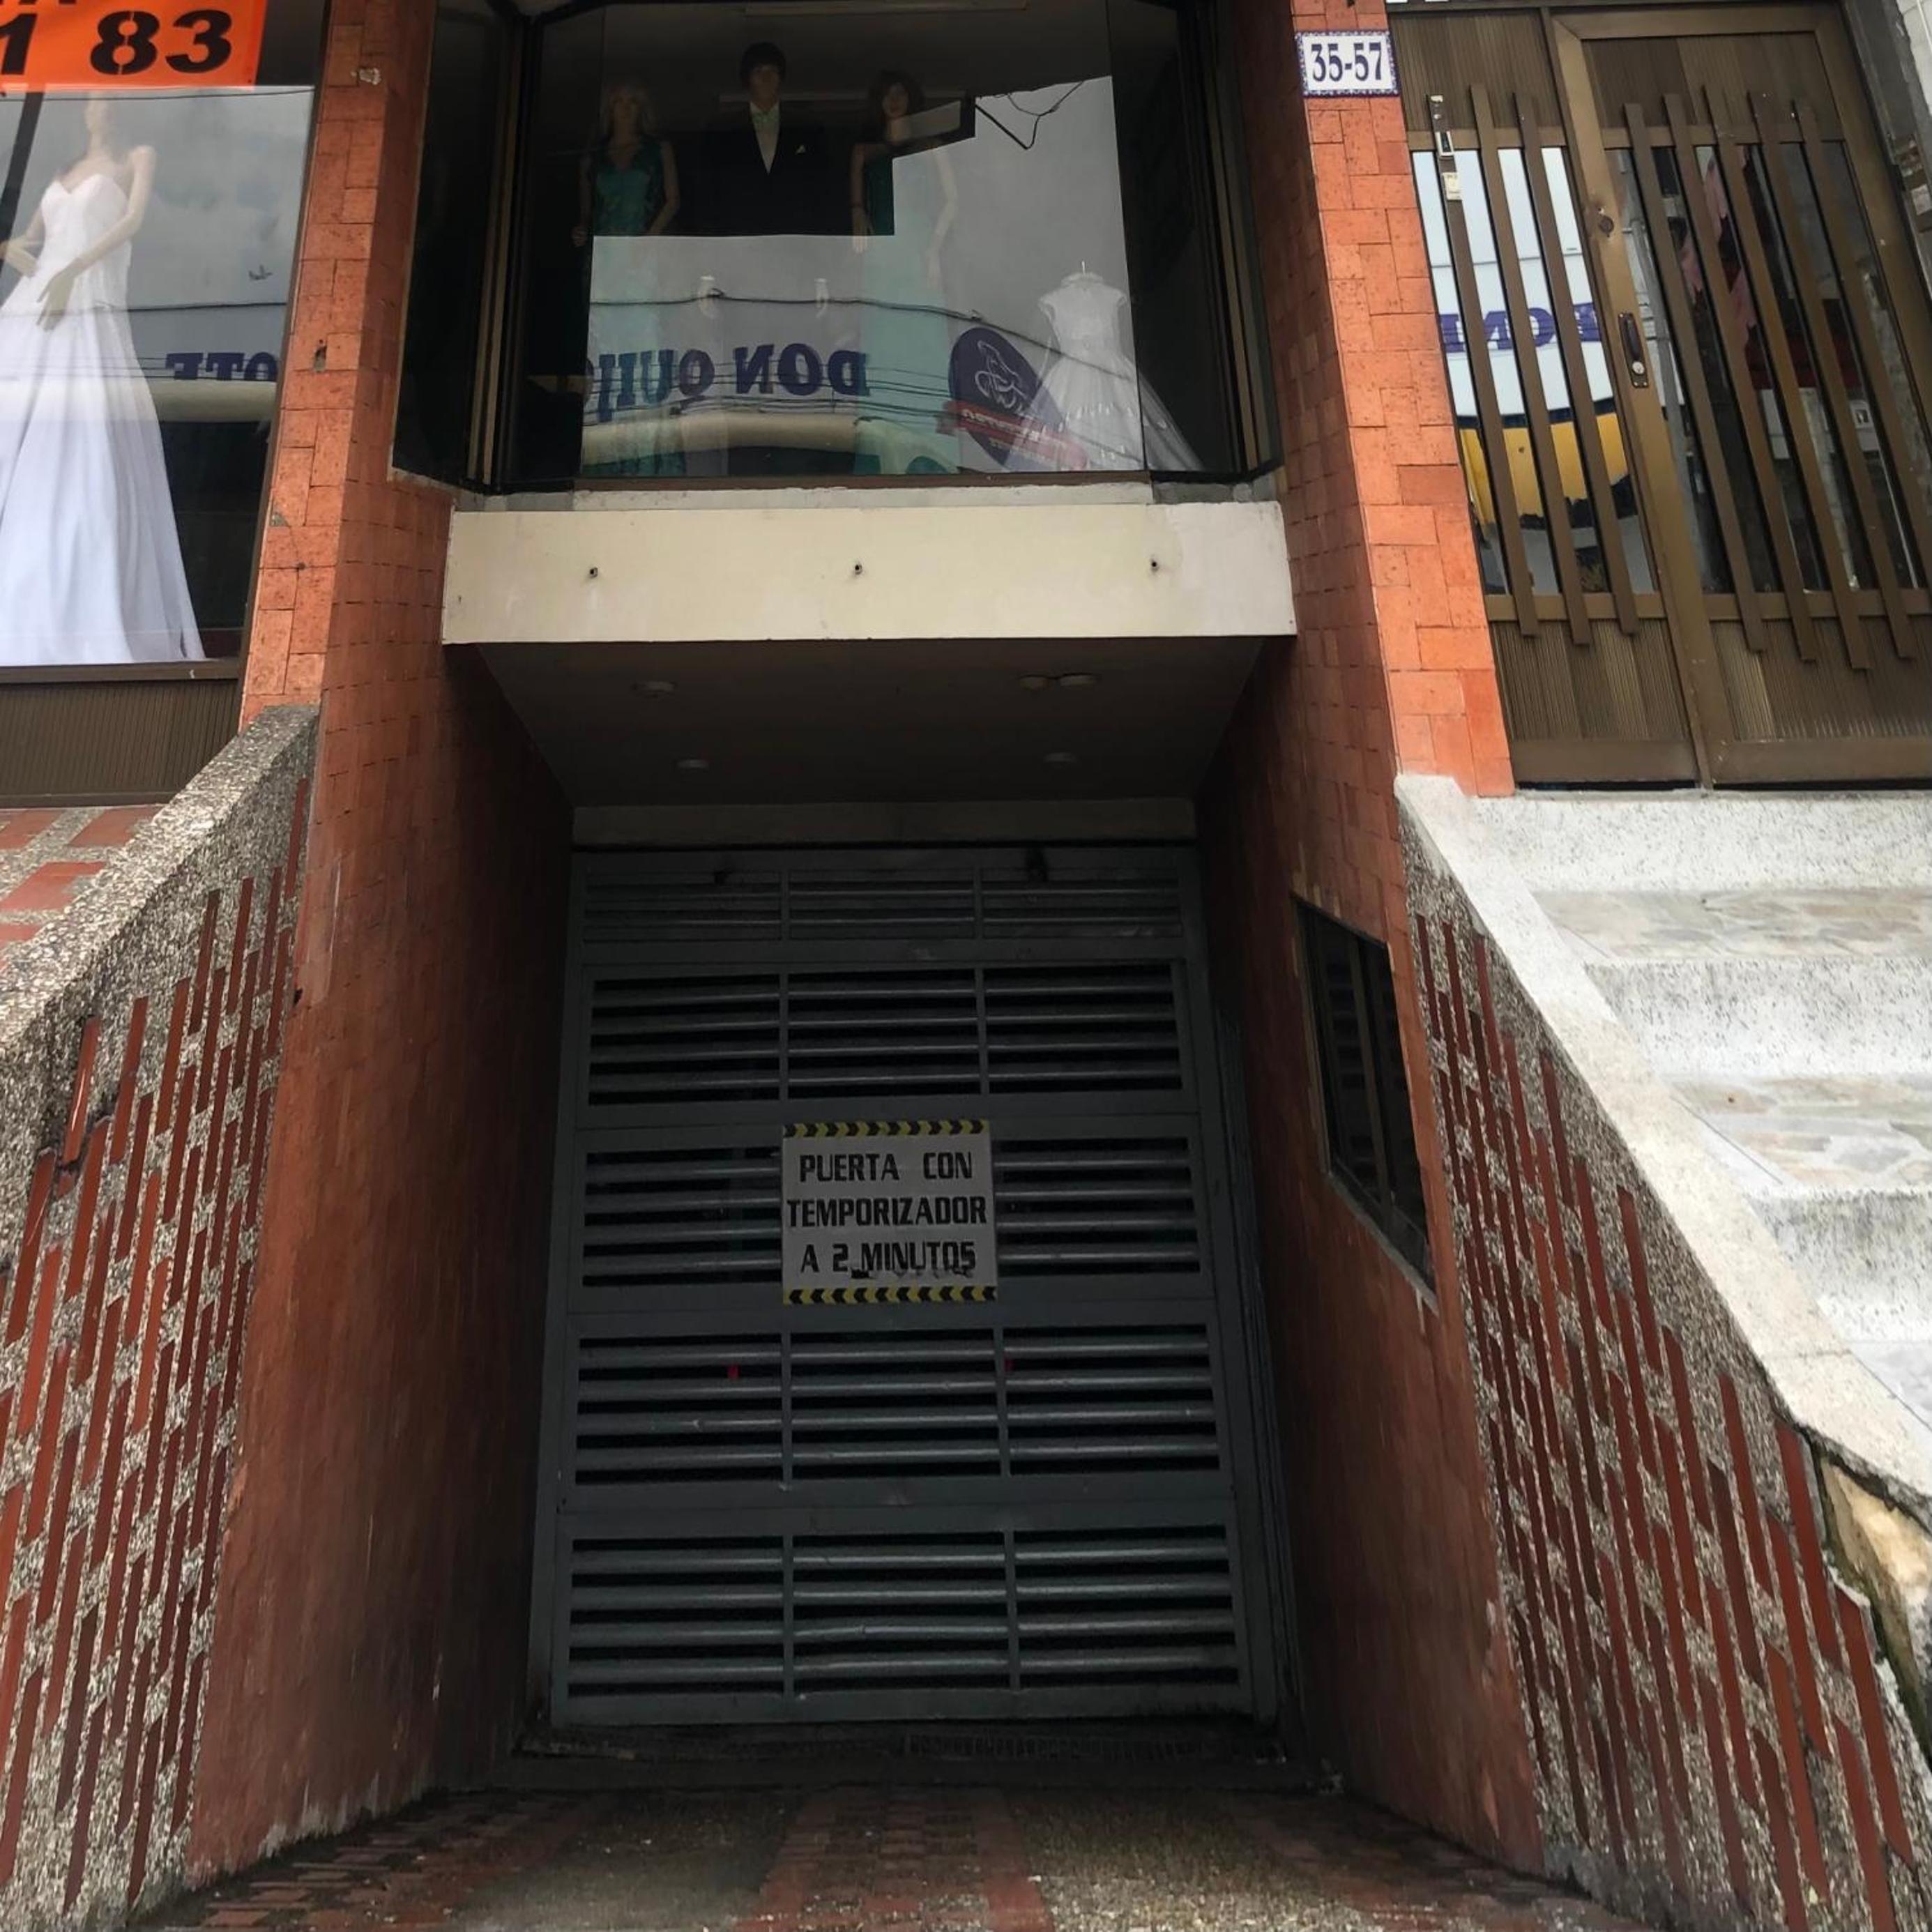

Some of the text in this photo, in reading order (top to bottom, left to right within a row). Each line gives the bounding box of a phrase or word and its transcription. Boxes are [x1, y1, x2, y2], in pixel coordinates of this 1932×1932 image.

[90, 9, 233, 75] 83
[1311, 42, 1382, 82] 35-57
[800, 1152, 973, 1183] PUERTA CON
[786, 1196, 987, 1228] TEMPORIZADOR
[801, 1241, 976, 1273] A 2 MINUTOS
